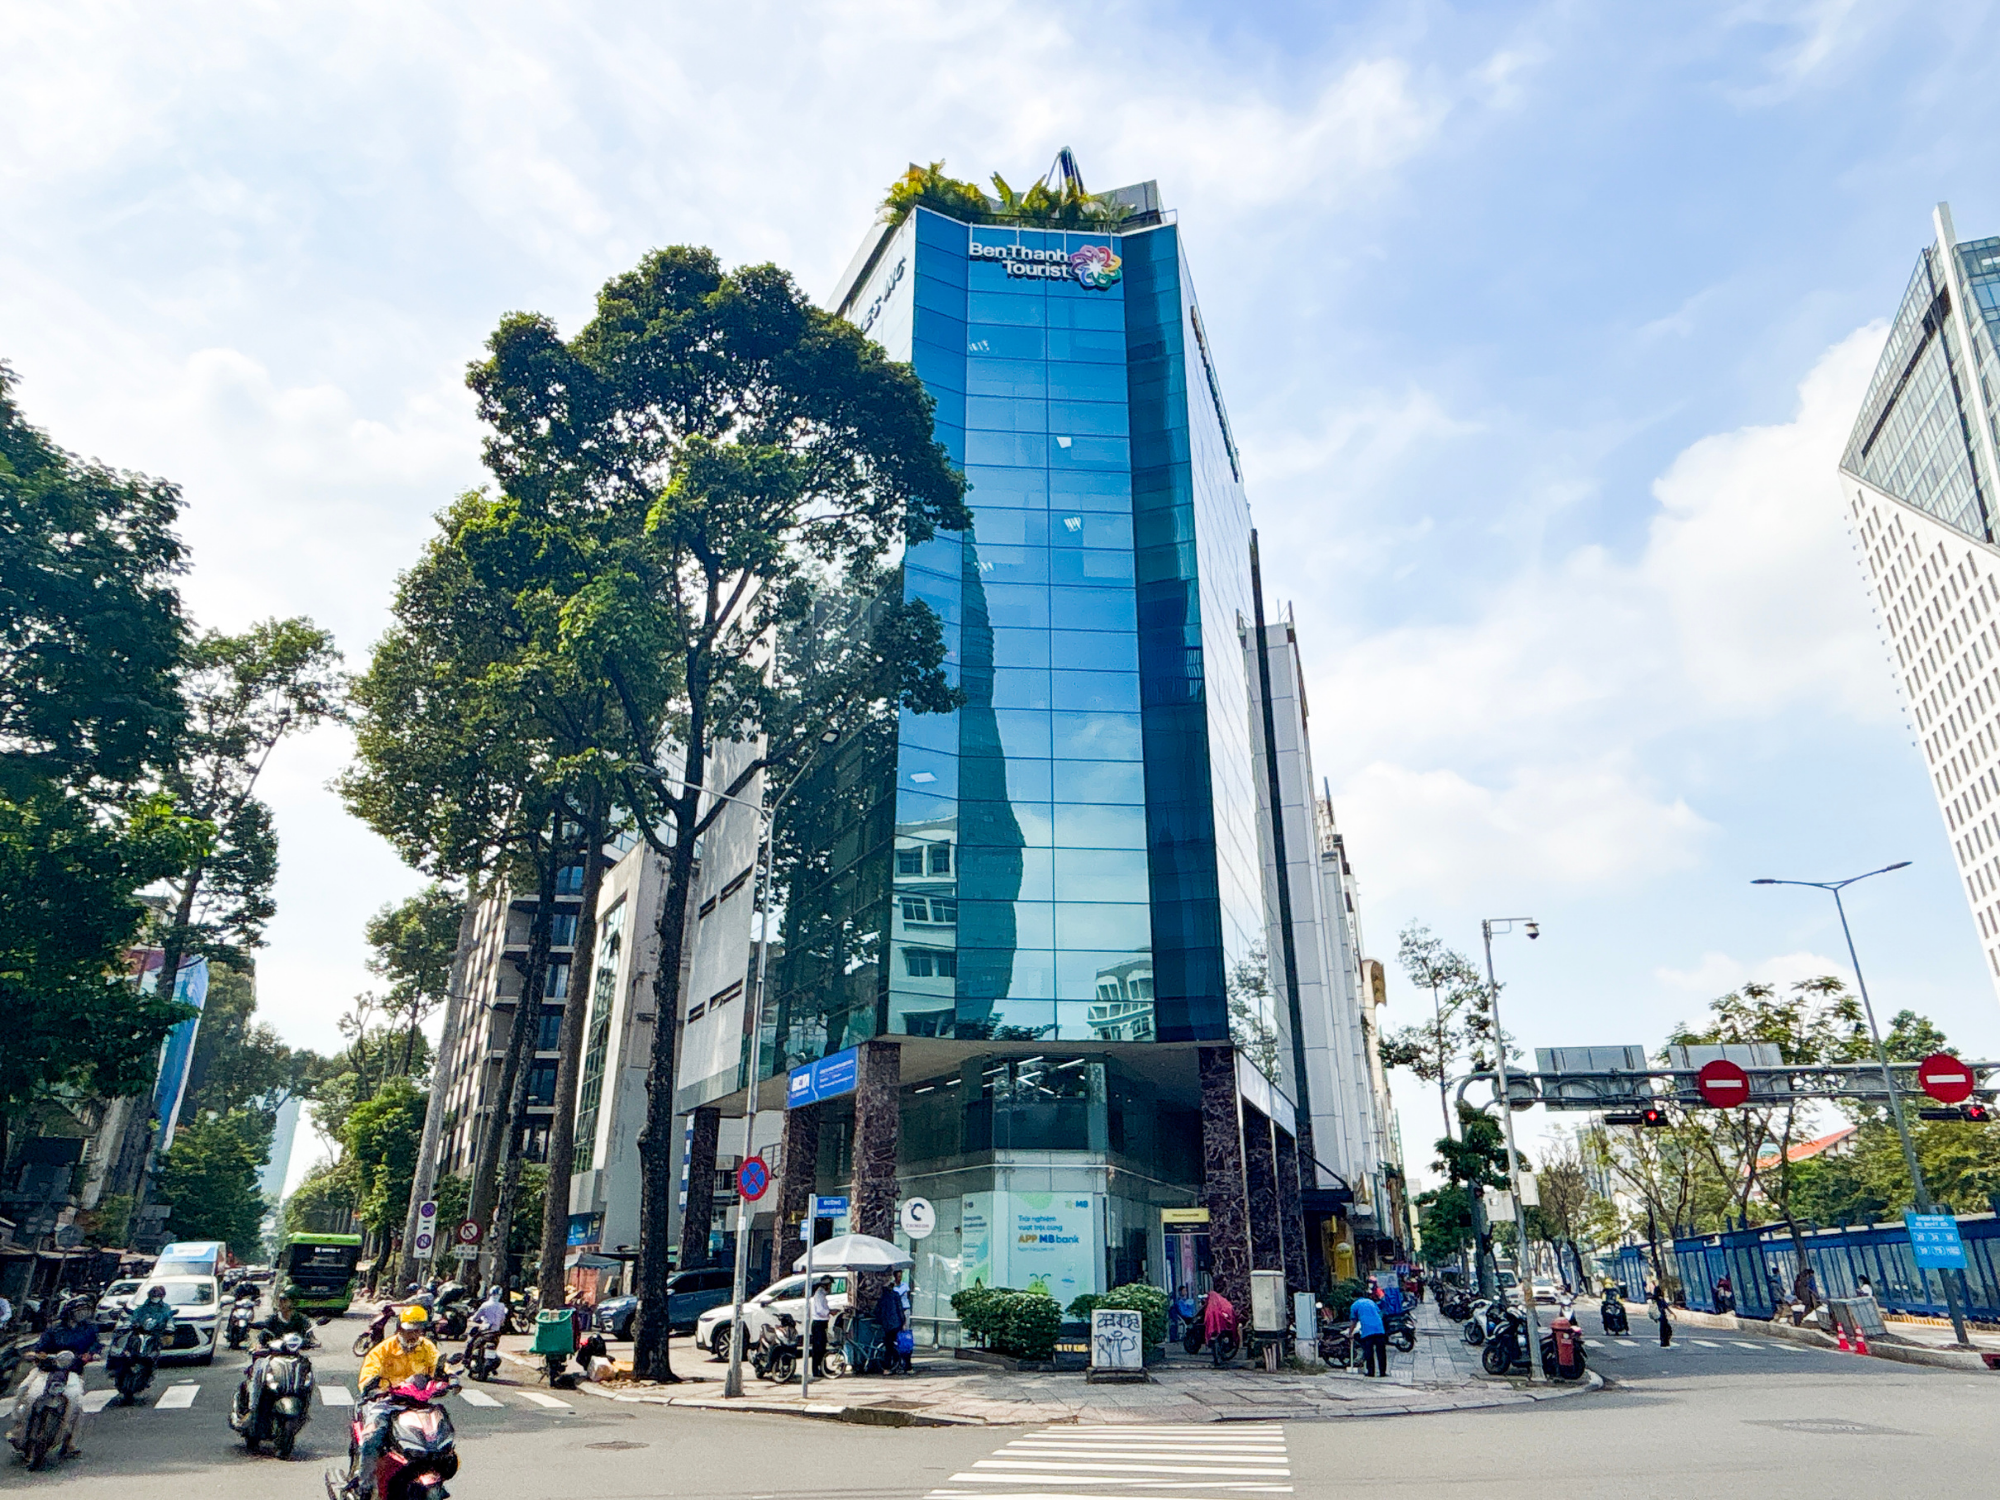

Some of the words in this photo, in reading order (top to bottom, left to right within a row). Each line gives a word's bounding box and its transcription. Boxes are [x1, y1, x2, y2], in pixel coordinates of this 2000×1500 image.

[969, 242, 1068, 261] BenThanh
[1002, 259, 1069, 278] Tourist
[1075, 1200, 1088, 1208] MB
[1018, 1234, 1037, 1243] APP
